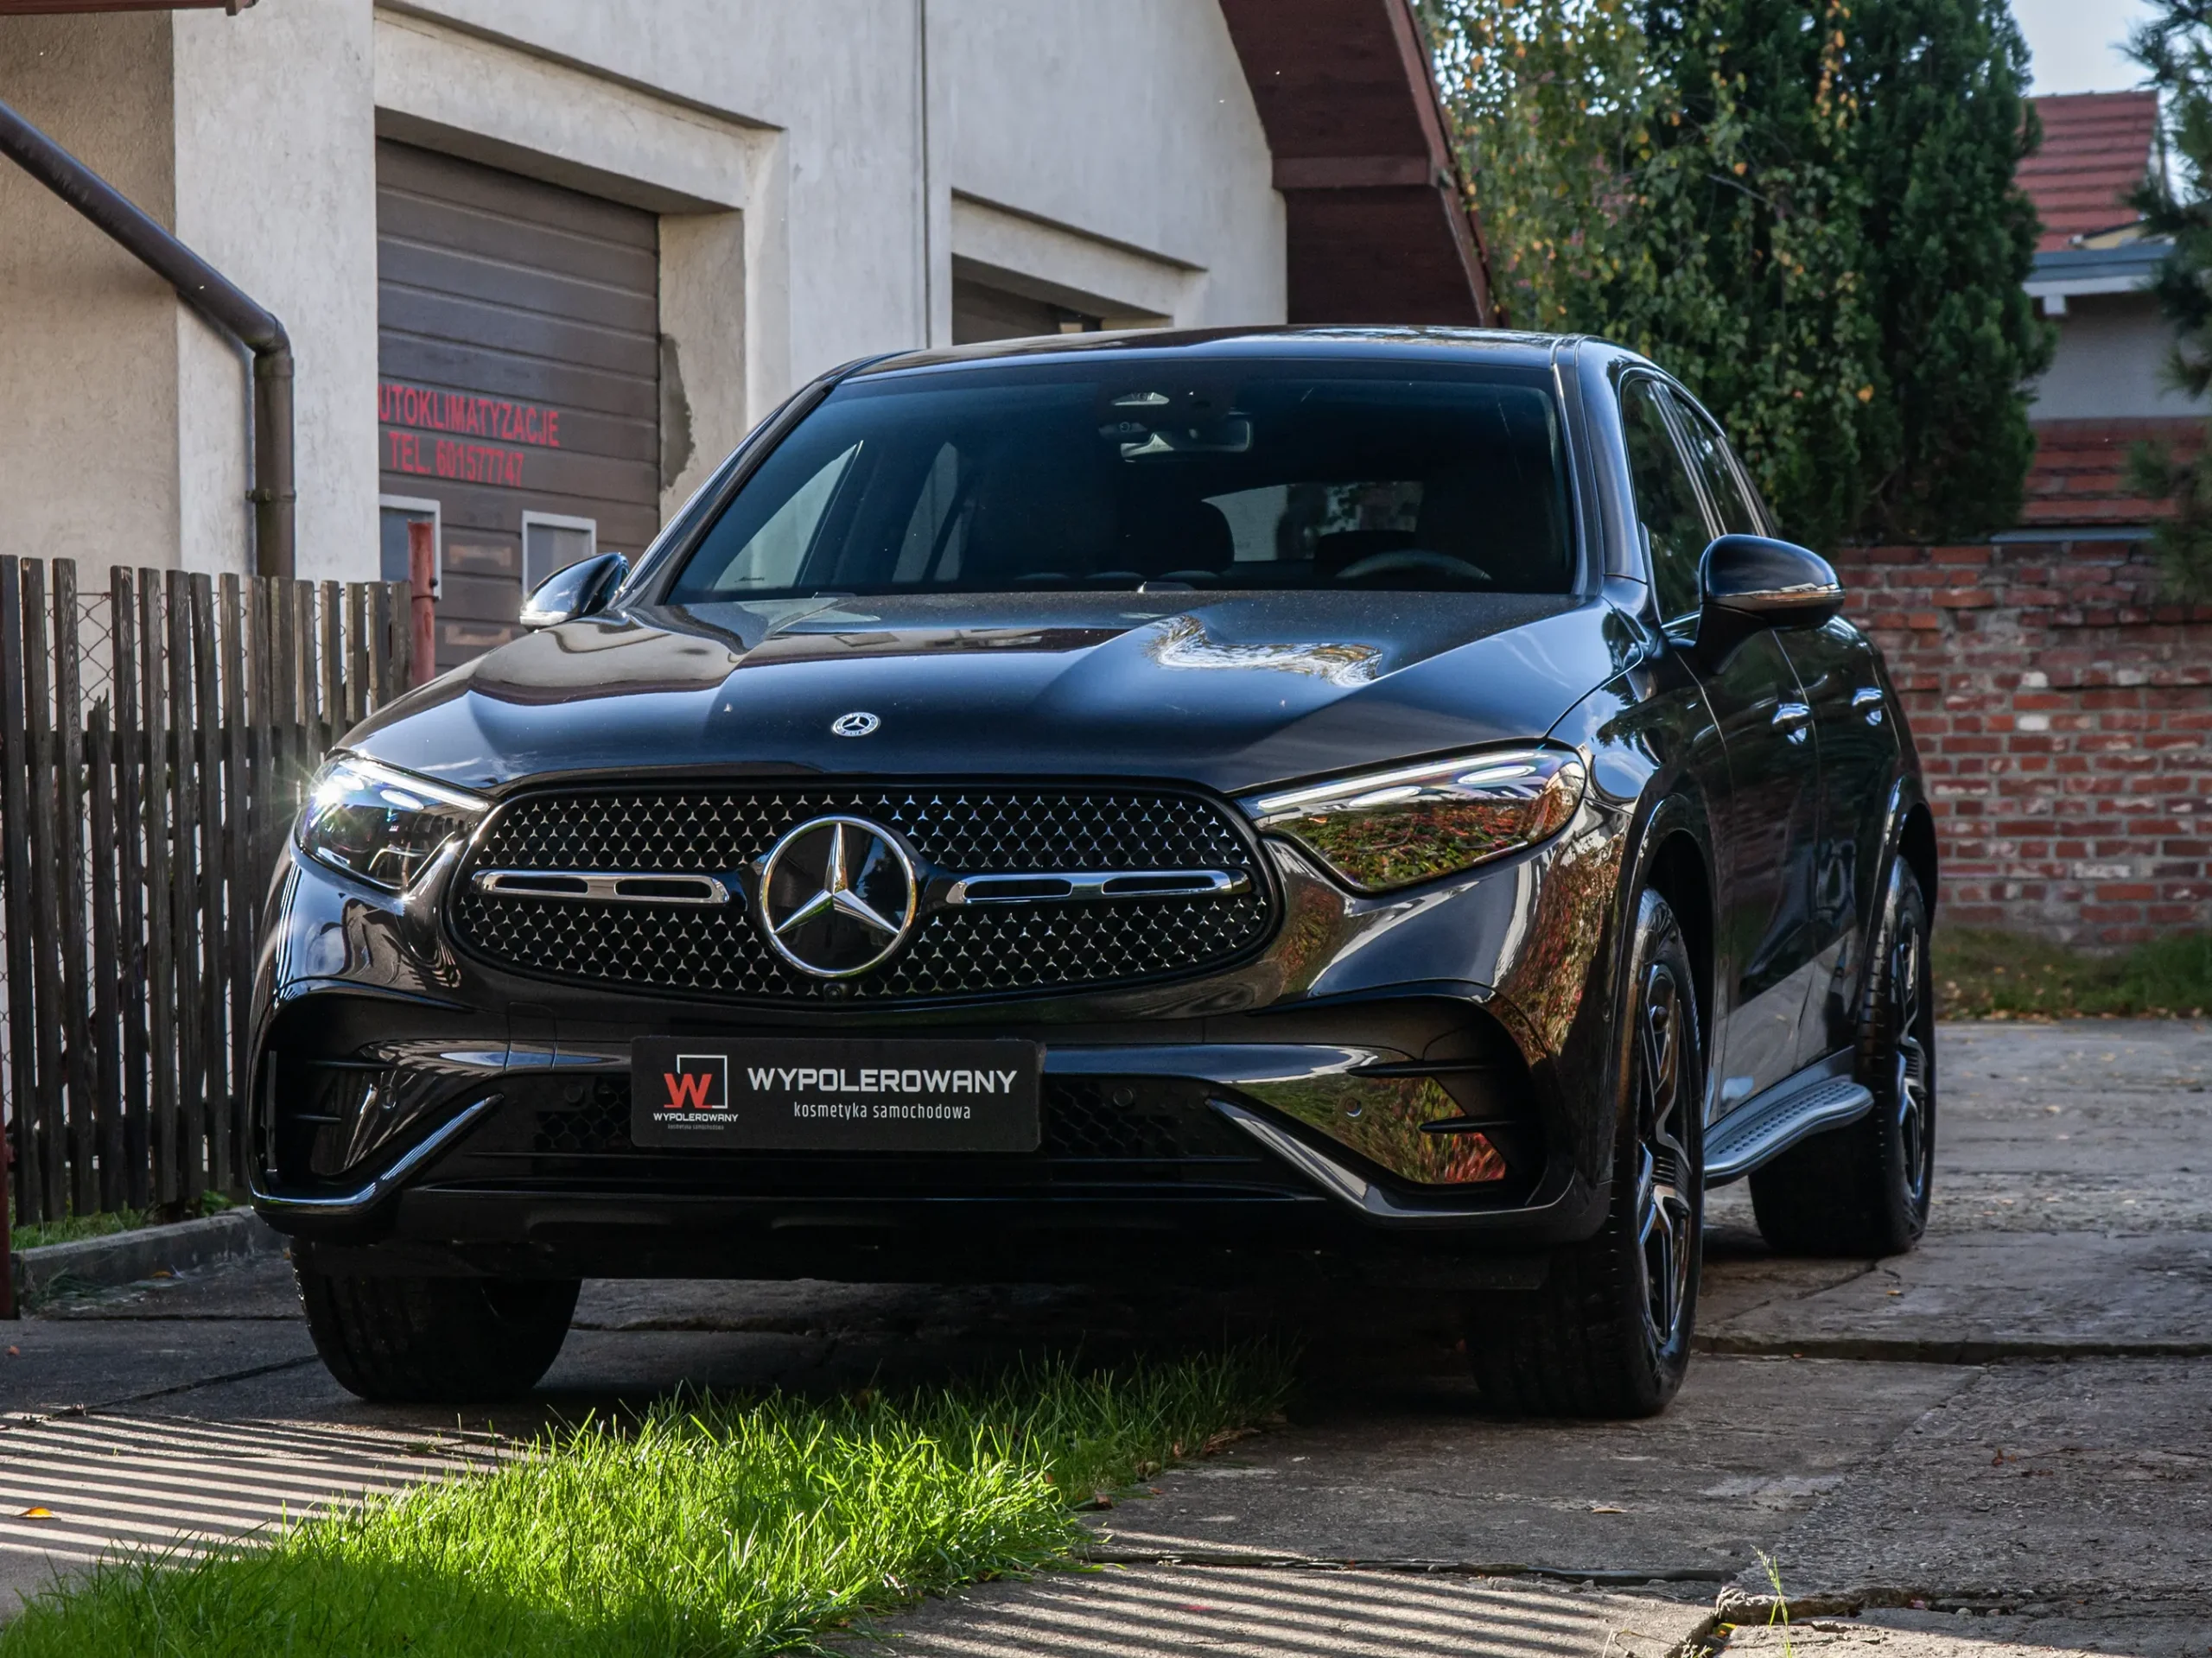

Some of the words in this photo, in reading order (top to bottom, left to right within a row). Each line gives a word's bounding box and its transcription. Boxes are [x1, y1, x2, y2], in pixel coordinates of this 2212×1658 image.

[389, 431, 430, 474] TEL.
[435, 440, 524, 487] 601577747
[664, 1073, 713, 1109] W
[747, 1068, 1017, 1093] WYPOLEROWANY
[653, 1113, 739, 1122] WYPOLEROWANY
[794, 1102, 867, 1121] kosmetyka
[873, 1103, 970, 1120] samochodowa
